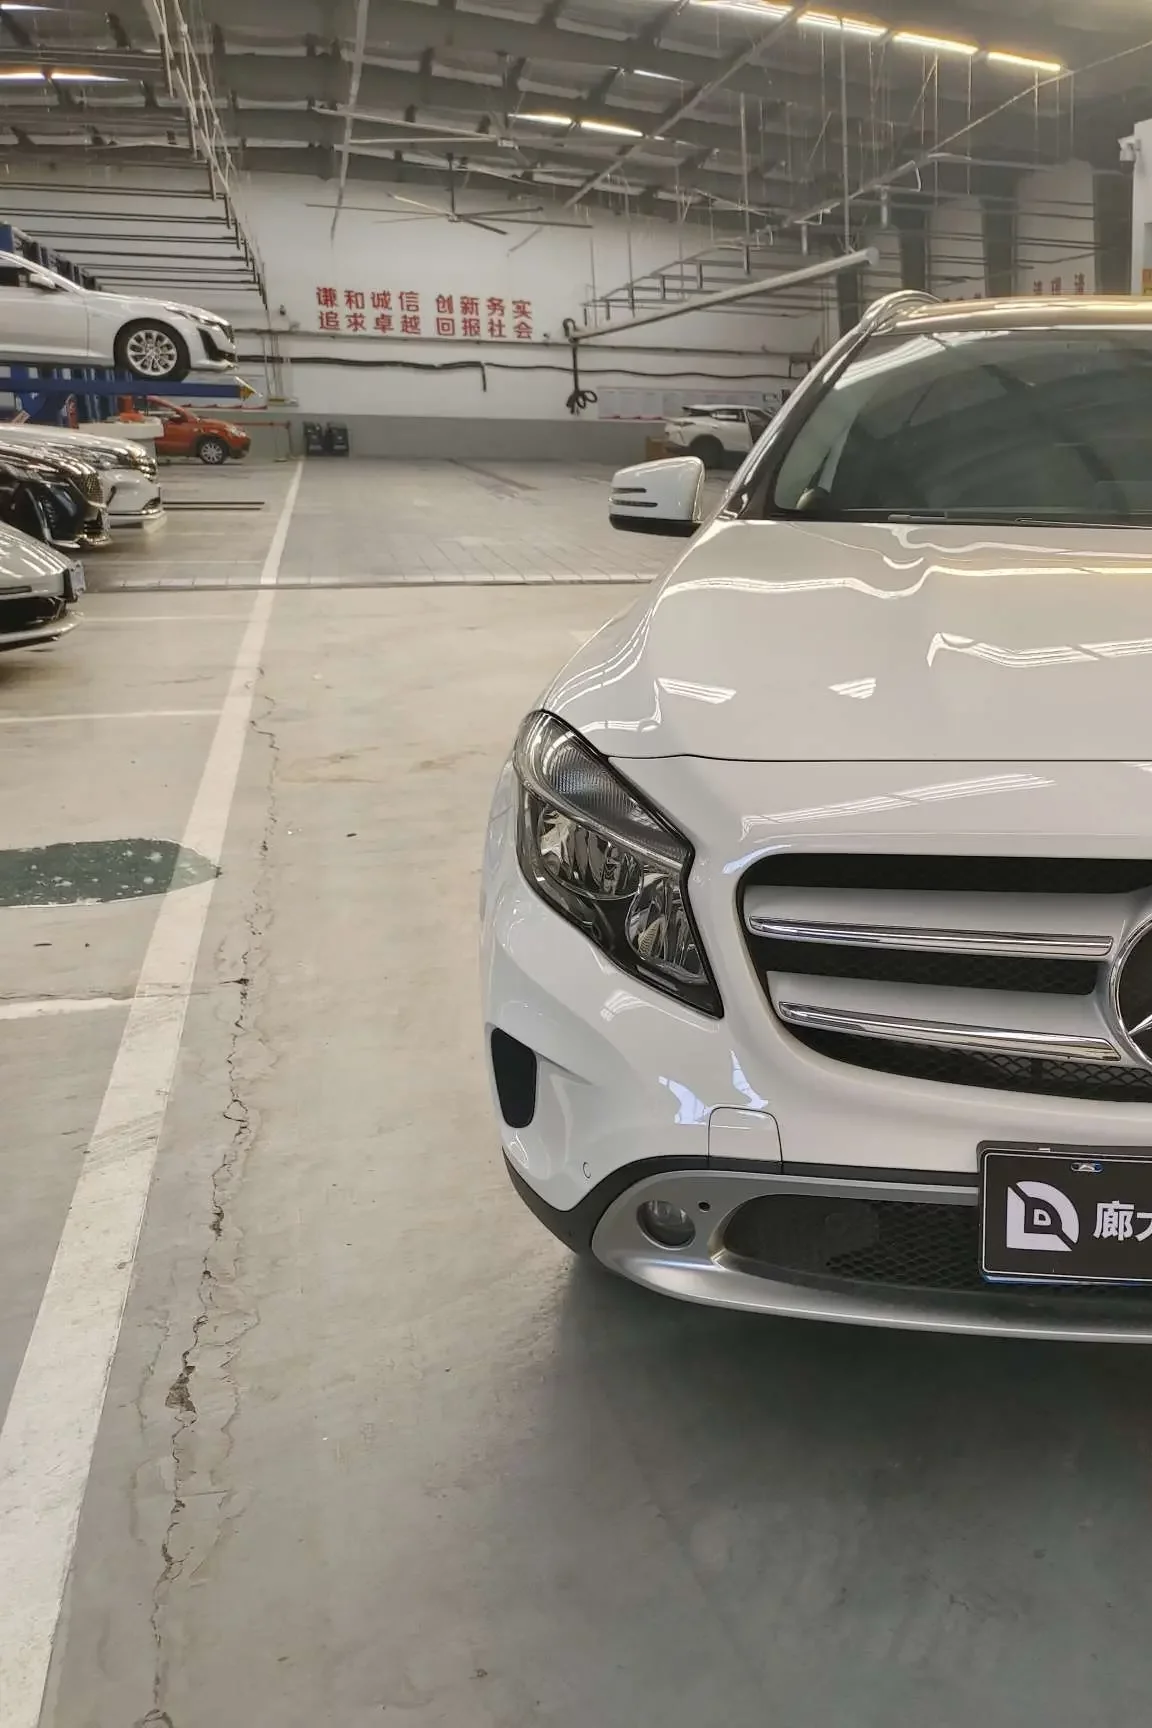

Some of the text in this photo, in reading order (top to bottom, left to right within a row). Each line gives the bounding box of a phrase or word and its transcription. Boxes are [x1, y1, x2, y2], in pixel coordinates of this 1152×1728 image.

[316, 287, 533, 320] 谦和诚信 创新务实
[318, 311, 533, 339] 追求卓越 回报社会
